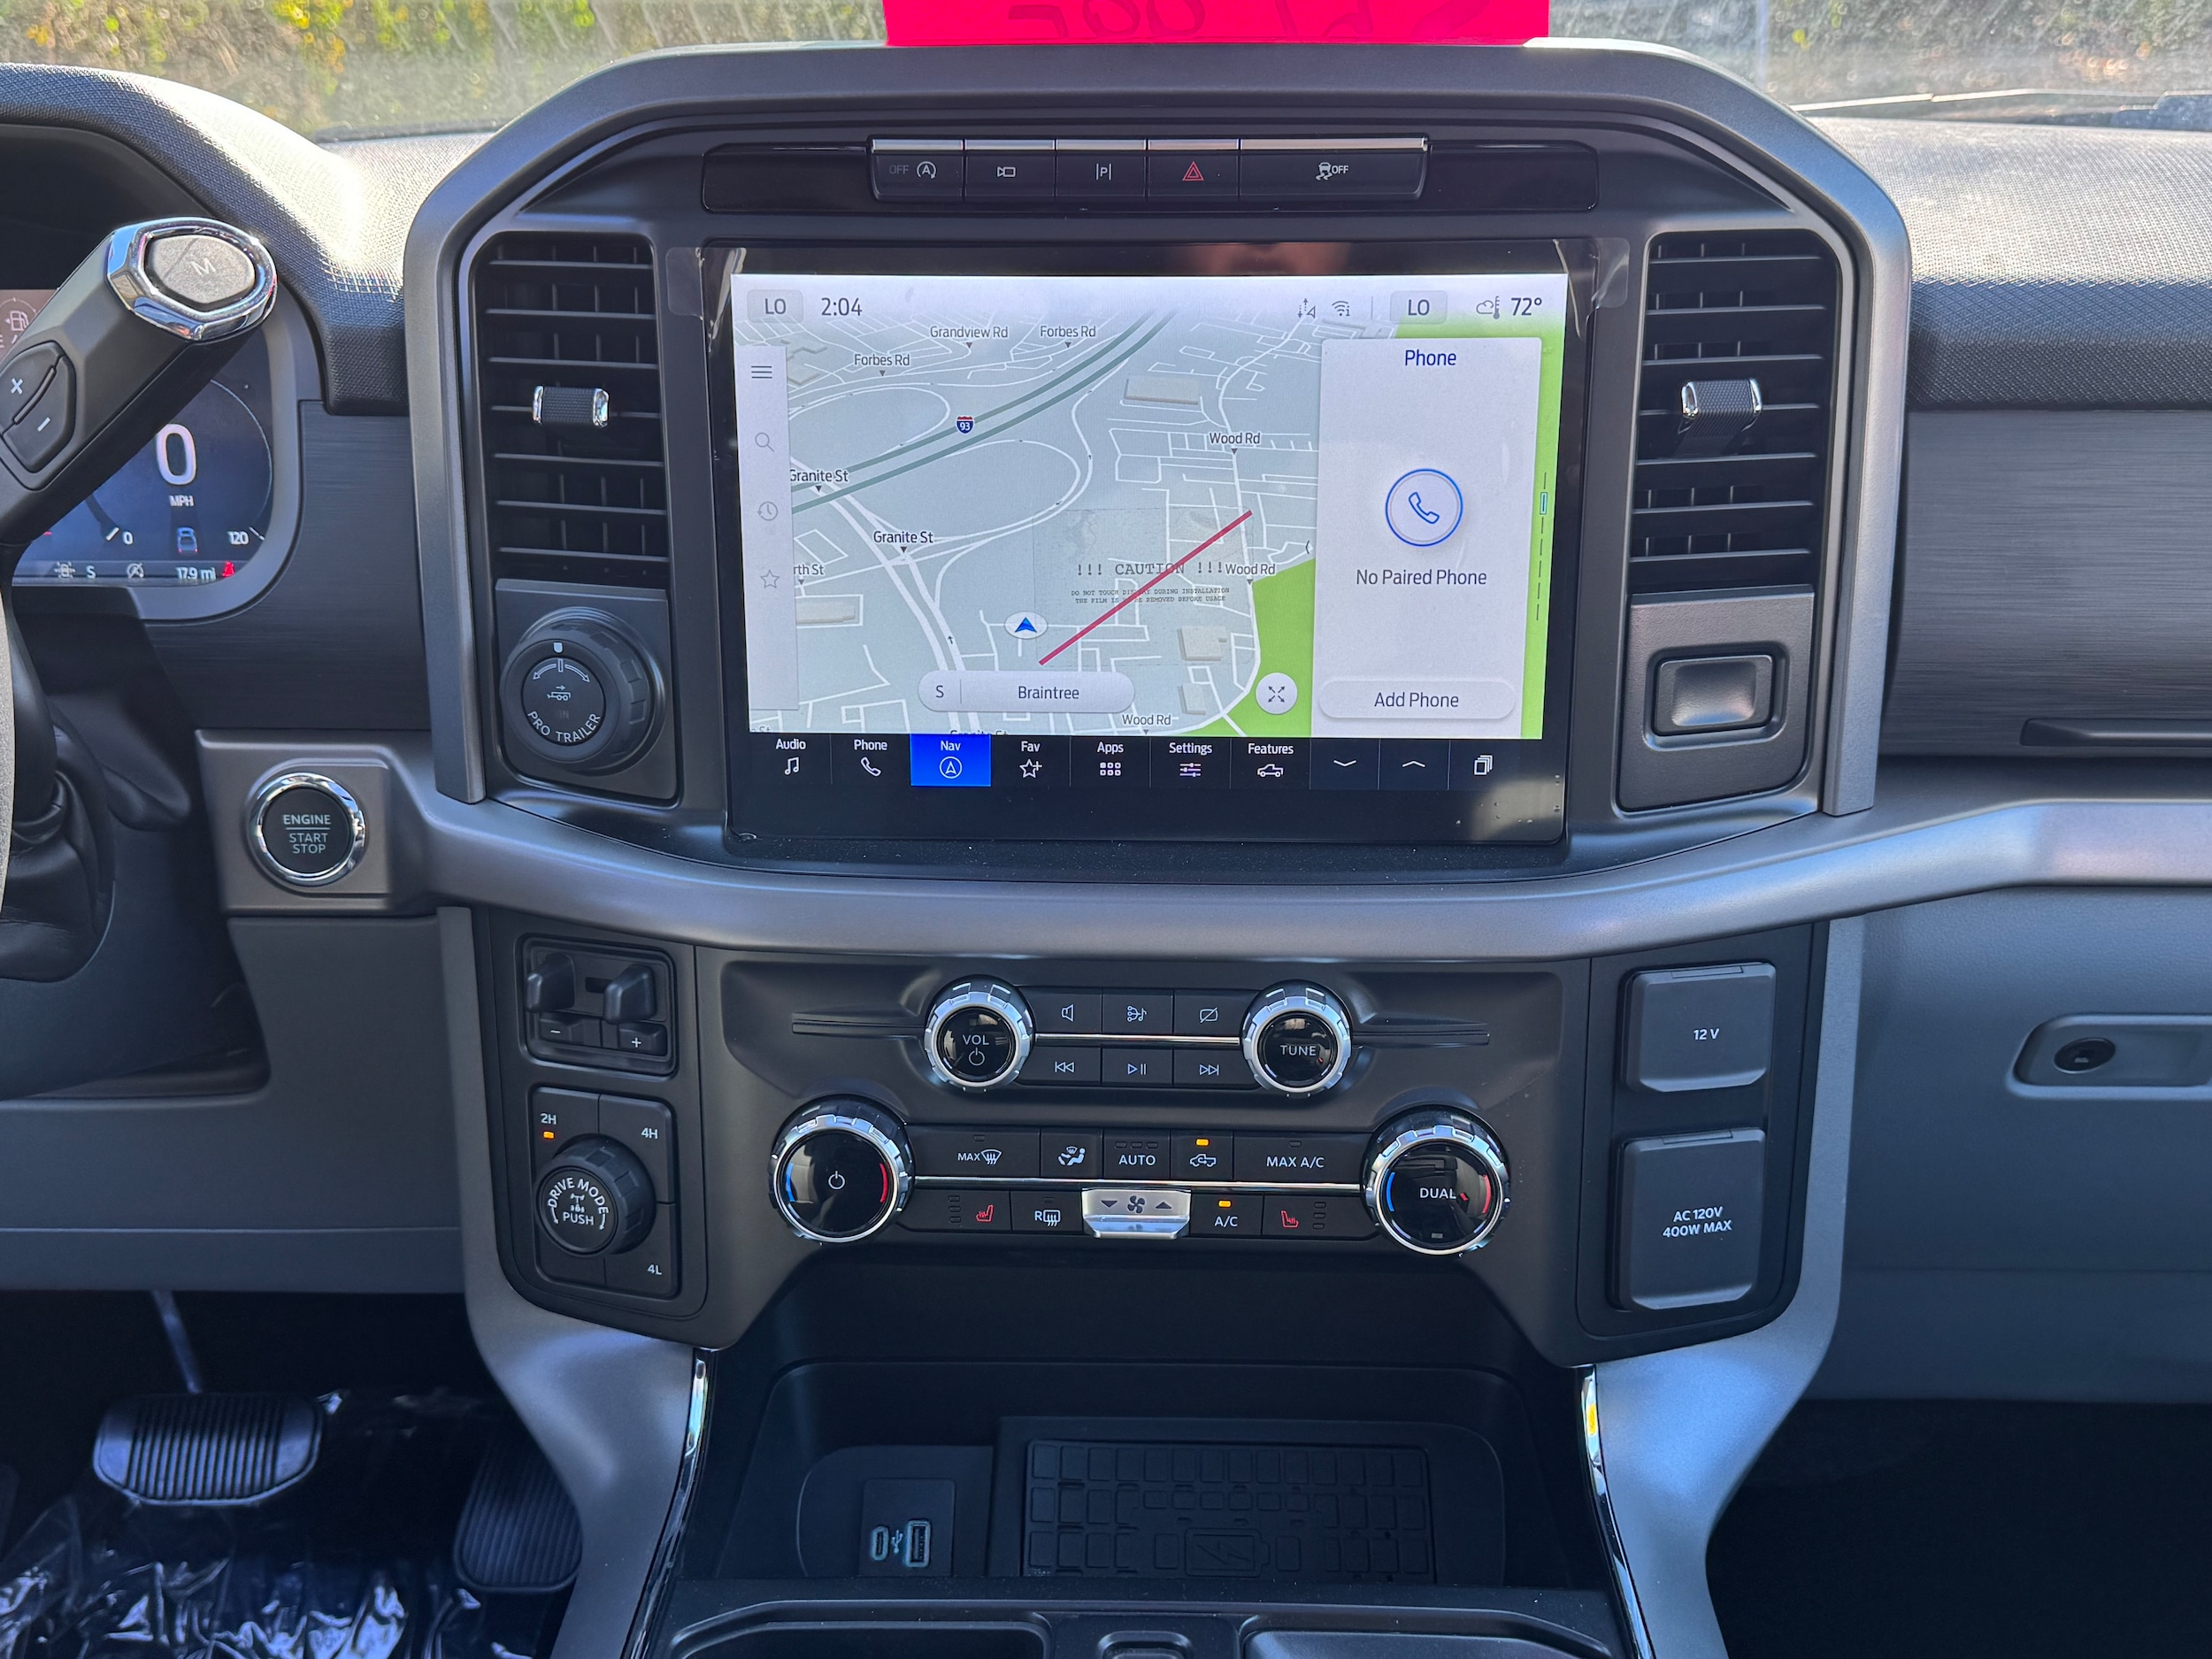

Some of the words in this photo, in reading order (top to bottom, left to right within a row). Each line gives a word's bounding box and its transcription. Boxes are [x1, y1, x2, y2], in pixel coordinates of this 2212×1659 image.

[1331, 165, 1349, 174] OFF
[764, 298, 787, 315] LO
[821, 297, 863, 317] 2:04
[1408, 299, 1430, 316] LO
[1510, 297, 1543, 317] 72°
[930, 326, 990, 339] Grandview
[992, 326, 1009, 339] Rd
[1040, 325, 1078, 339] Forbes
[1080, 325, 1096, 338] Rd
[854, 354, 892, 367] Forbes
[895, 353, 910, 366] Rd
[1404, 349, 1457, 367] Phone
[960, 421, 971, 431] 93
[1210, 432, 1241, 445] Wood
[1244, 432, 1261, 445] Rd
[156, 424, 196, 486] 0
[835, 469, 849, 482] St
[170, 495, 194, 507] MPH
[123, 532, 133, 544] 0
[227, 531, 250, 545] 120
[873, 531, 918, 544] Granite
[918, 531, 933, 544] St
[87, 565, 96, 580] S
[201, 567, 216, 580] mi
[811, 564, 825, 575] St
[1225, 563, 1257, 575] Wood
[1260, 563, 1276, 575] Rd
[1356, 570, 1378, 586] No
[1382, 570, 1435, 586] Paired
[1437, 569, 1487, 586] Phone
[935, 685, 944, 699] S
[1018, 686, 1079, 700] Braintree
[1374, 693, 1406, 708] Add
[1409, 693, 1459, 708] Phone
[527, 710, 550, 736] PRO
[556, 713, 602, 742] TRAILER
[1122, 714, 1153, 726] Wood
[1156, 714, 1171, 726] Rd
[776, 738, 807, 751] Audio
[854, 739, 887, 751] Phone
[940, 740, 961, 751] Nav
[1021, 741, 1041, 753] Fav
[1097, 741, 1125, 755] Apps
[1169, 742, 1213, 757] Settings
[1248, 743, 1294, 755] Features
[283, 814, 332, 825] ENGINE
[289, 833, 328, 842] START
[293, 844, 326, 854] STOP
[963, 1034, 989, 1046] VOL
[1693, 1029, 1708, 1041] 12
[1709, 1028, 1720, 1040] V
[1280, 1045, 1317, 1056] TUNE
[540, 1113, 557, 1125] 2H
[641, 1128, 658, 1140] 4H
[958, 1152, 980, 1162] MAX
[1118, 1155, 1156, 1166] AUTO
[1266, 1156, 1297, 1168] MAX
[1301, 1156, 1325, 1169] A/C
[548, 1178, 575, 1208] DRIVE
[578, 1179, 610, 1214] MODE
[1419, 1187, 1456, 1200] DUAL
[563, 1211, 594, 1225] PUSH
[1673, 1210, 1691, 1222] AC
[1693, 1206, 1724, 1220] 120V
[1215, 1216, 1239, 1228] A/C
[1662, 1223, 1701, 1238] 400W
[1702, 1220, 1732, 1233] MAX
[647, 1264, 662, 1276] 4L
